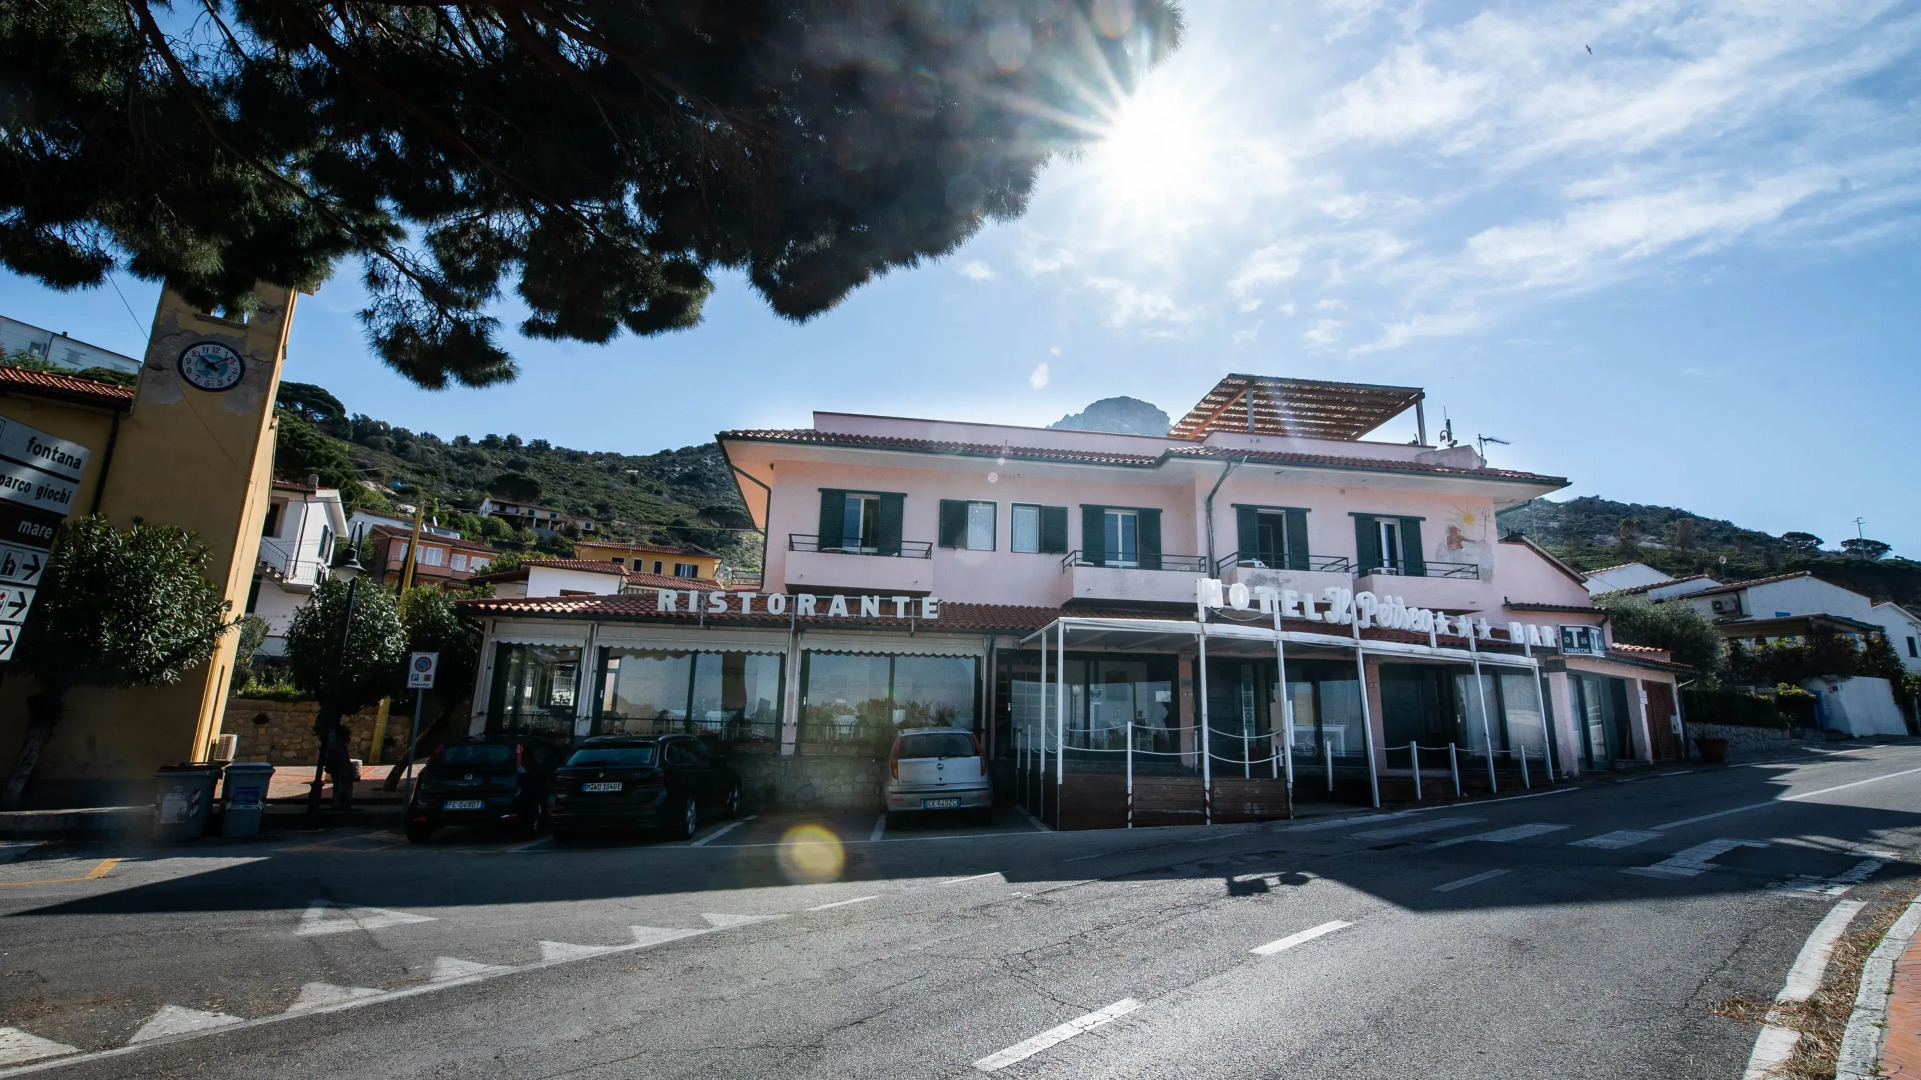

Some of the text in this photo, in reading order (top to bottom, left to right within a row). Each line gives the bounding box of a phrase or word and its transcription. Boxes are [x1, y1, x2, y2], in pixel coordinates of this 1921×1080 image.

[26, 436, 82, 470] fontana
[35, 484, 72, 505] giochi
[18, 520, 53, 539] mare
[657, 590, 939, 619] RISTORANTE
[1201, 578, 1322, 621] HOTEL
[1507, 621, 1557, 648] BAR
[1566, 627, 1583, 648] T
[1591, 628, 1600, 649] T
